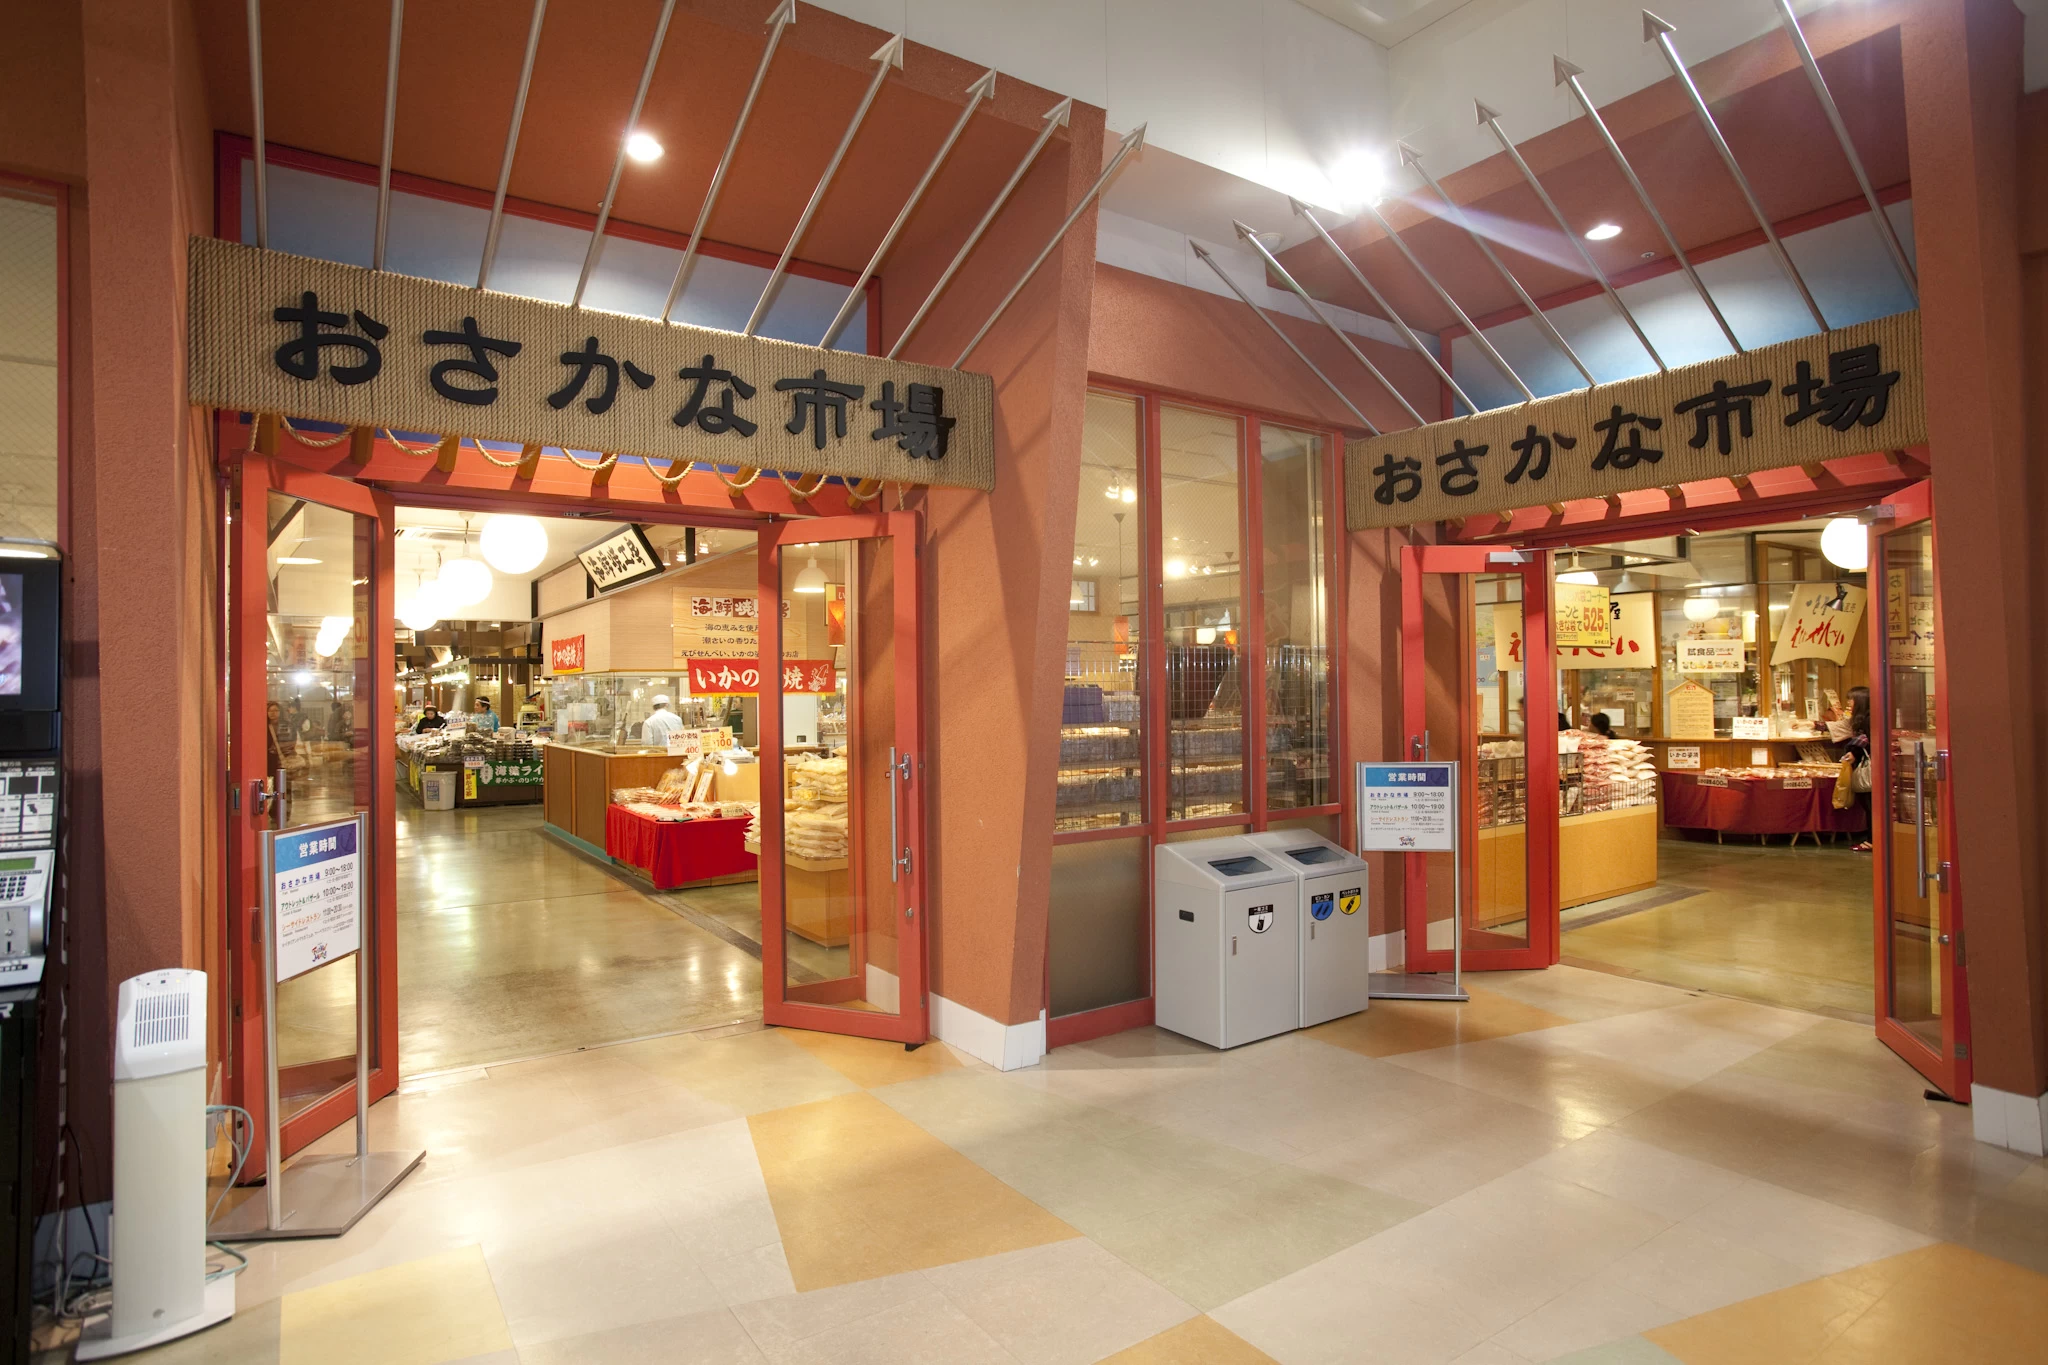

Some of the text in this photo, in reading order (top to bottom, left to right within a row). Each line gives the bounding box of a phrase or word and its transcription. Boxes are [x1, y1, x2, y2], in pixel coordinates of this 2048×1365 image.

[274, 291, 957, 461] おさかな市場
[1373, 343, 1900, 505] おさかな市場
[696, 665, 804, 690] いかの焼
[1387, 772, 1427, 782] 営業時間
[298, 836, 337, 858] 営業時間
